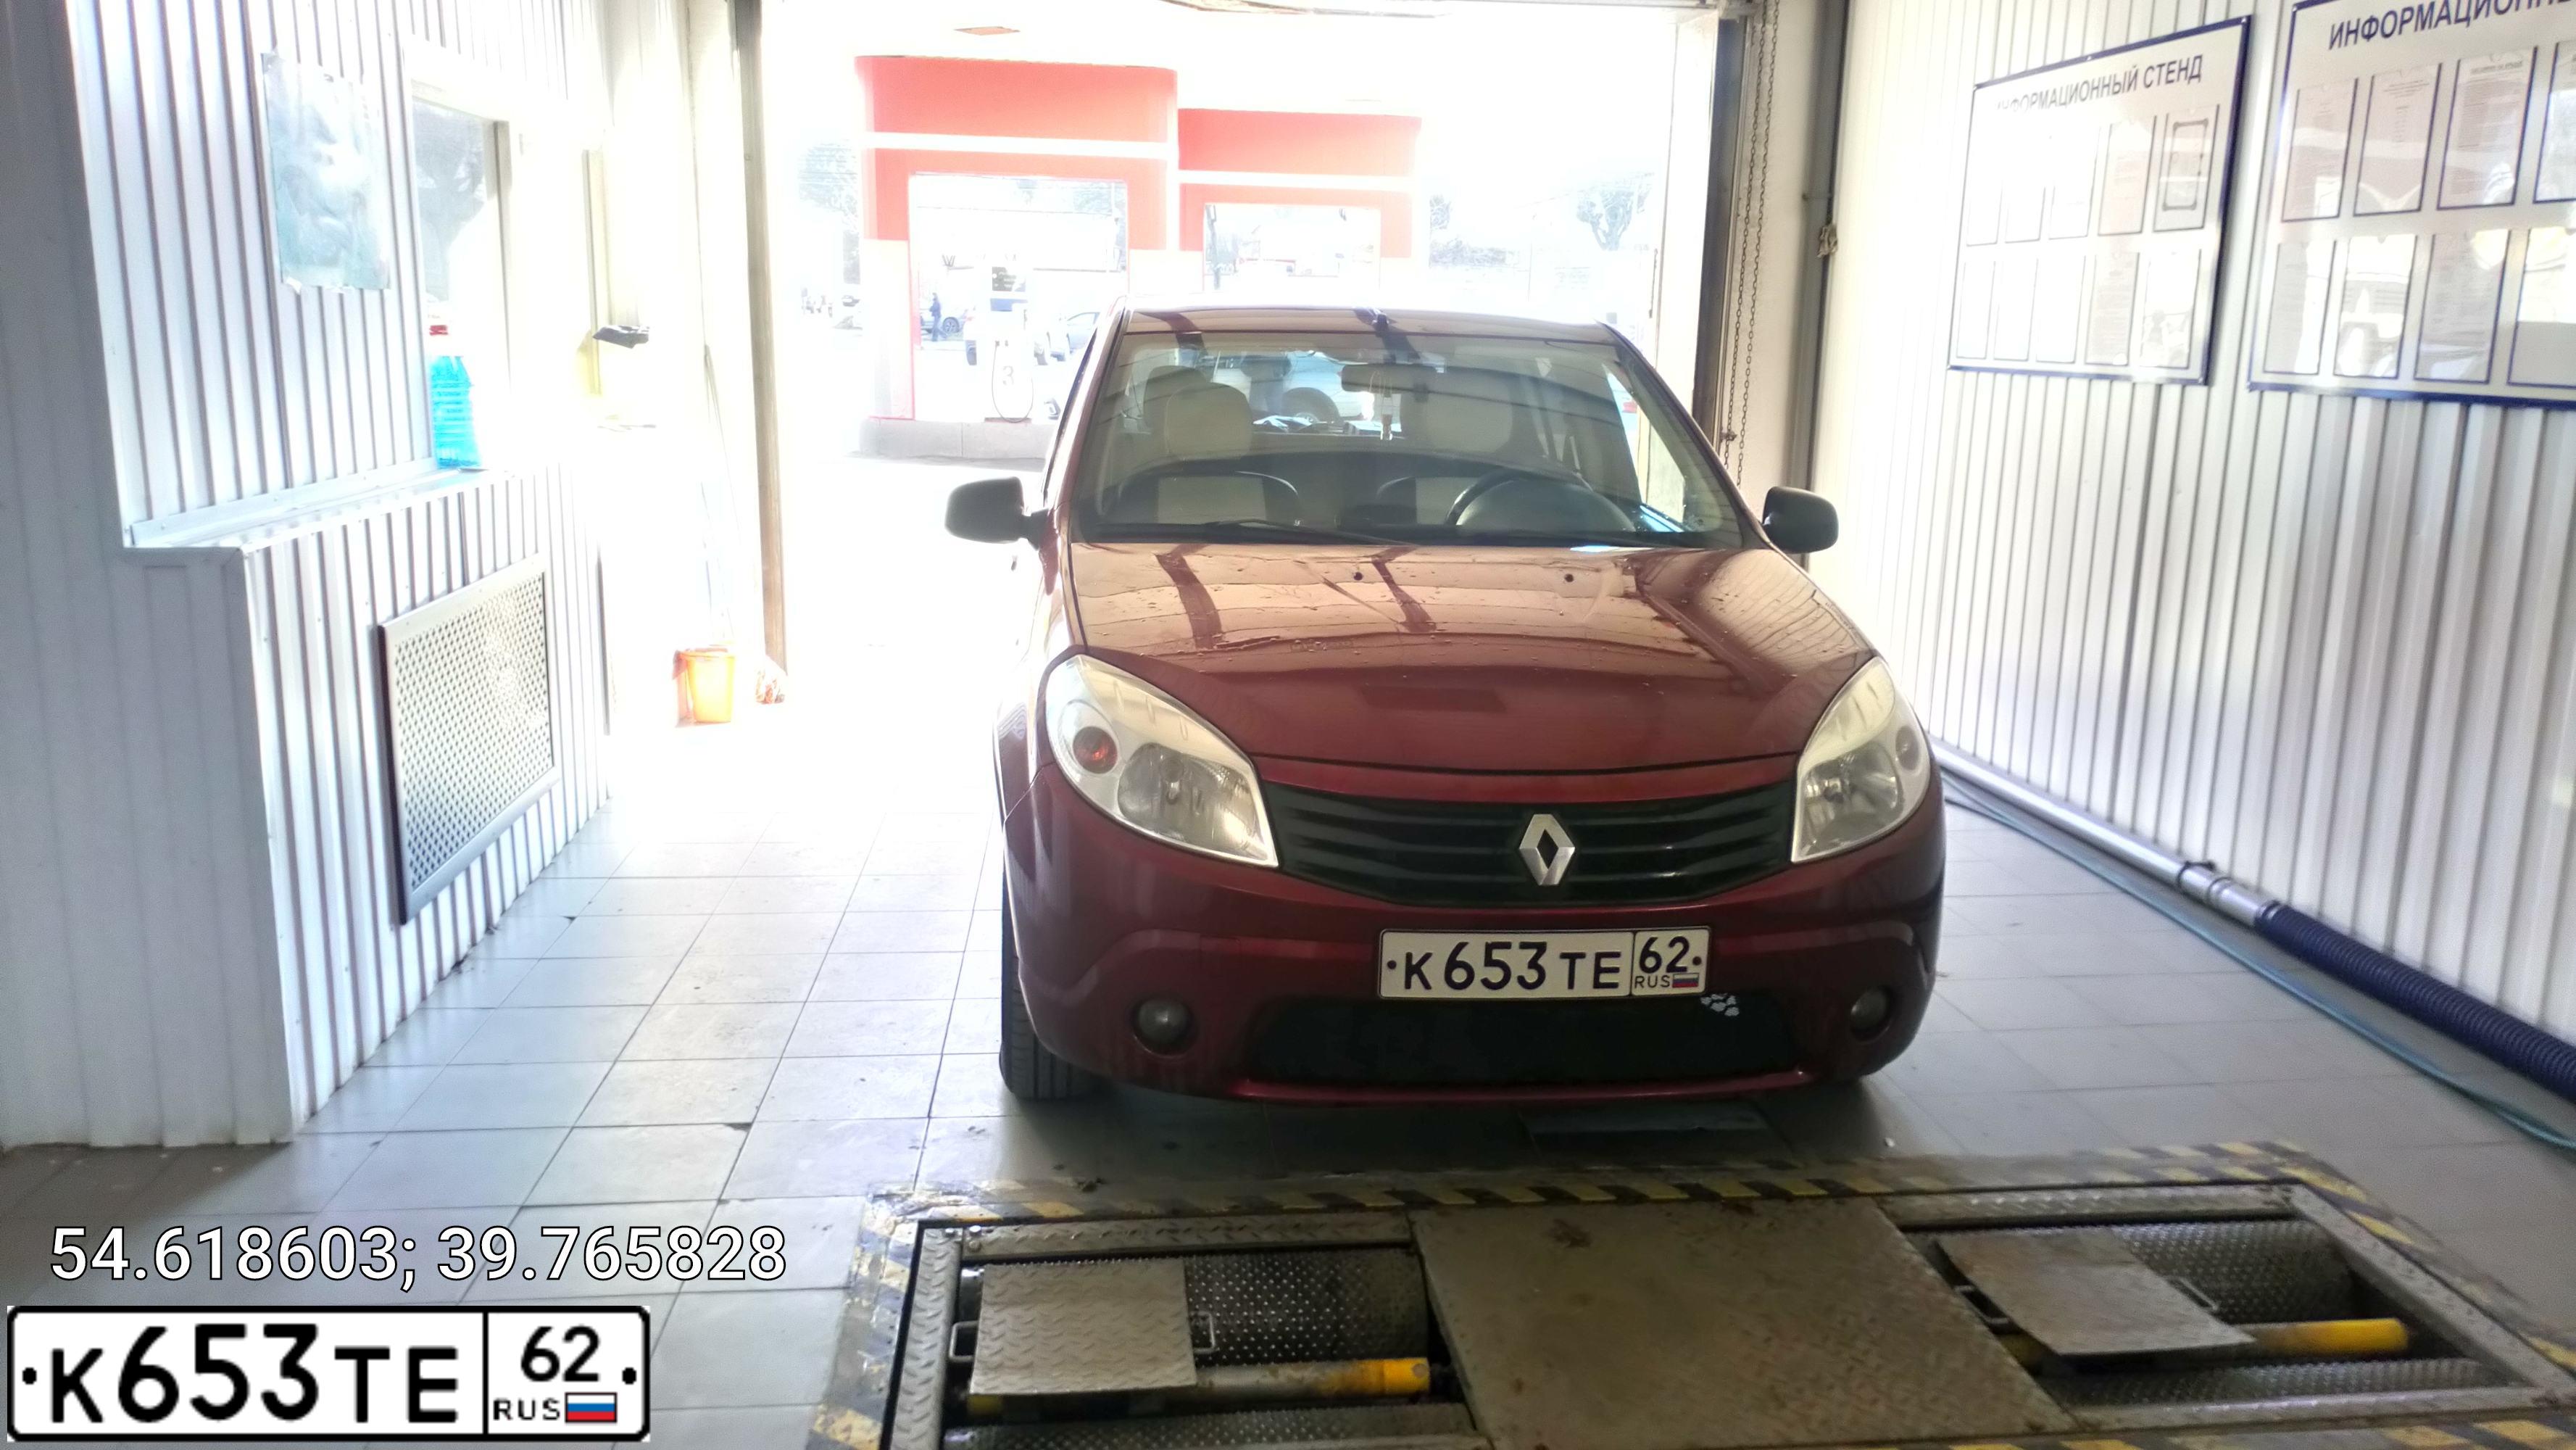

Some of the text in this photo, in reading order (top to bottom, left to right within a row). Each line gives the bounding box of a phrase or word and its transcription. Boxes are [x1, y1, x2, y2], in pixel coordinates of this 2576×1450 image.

[2328, 0, 2572, 50] ИНФОРМАЦИО
[2143, 54, 2203, 89] СТЕНД
[1638, 935, 1691, 974] 62
[1634, 974, 1671, 989] RUS
